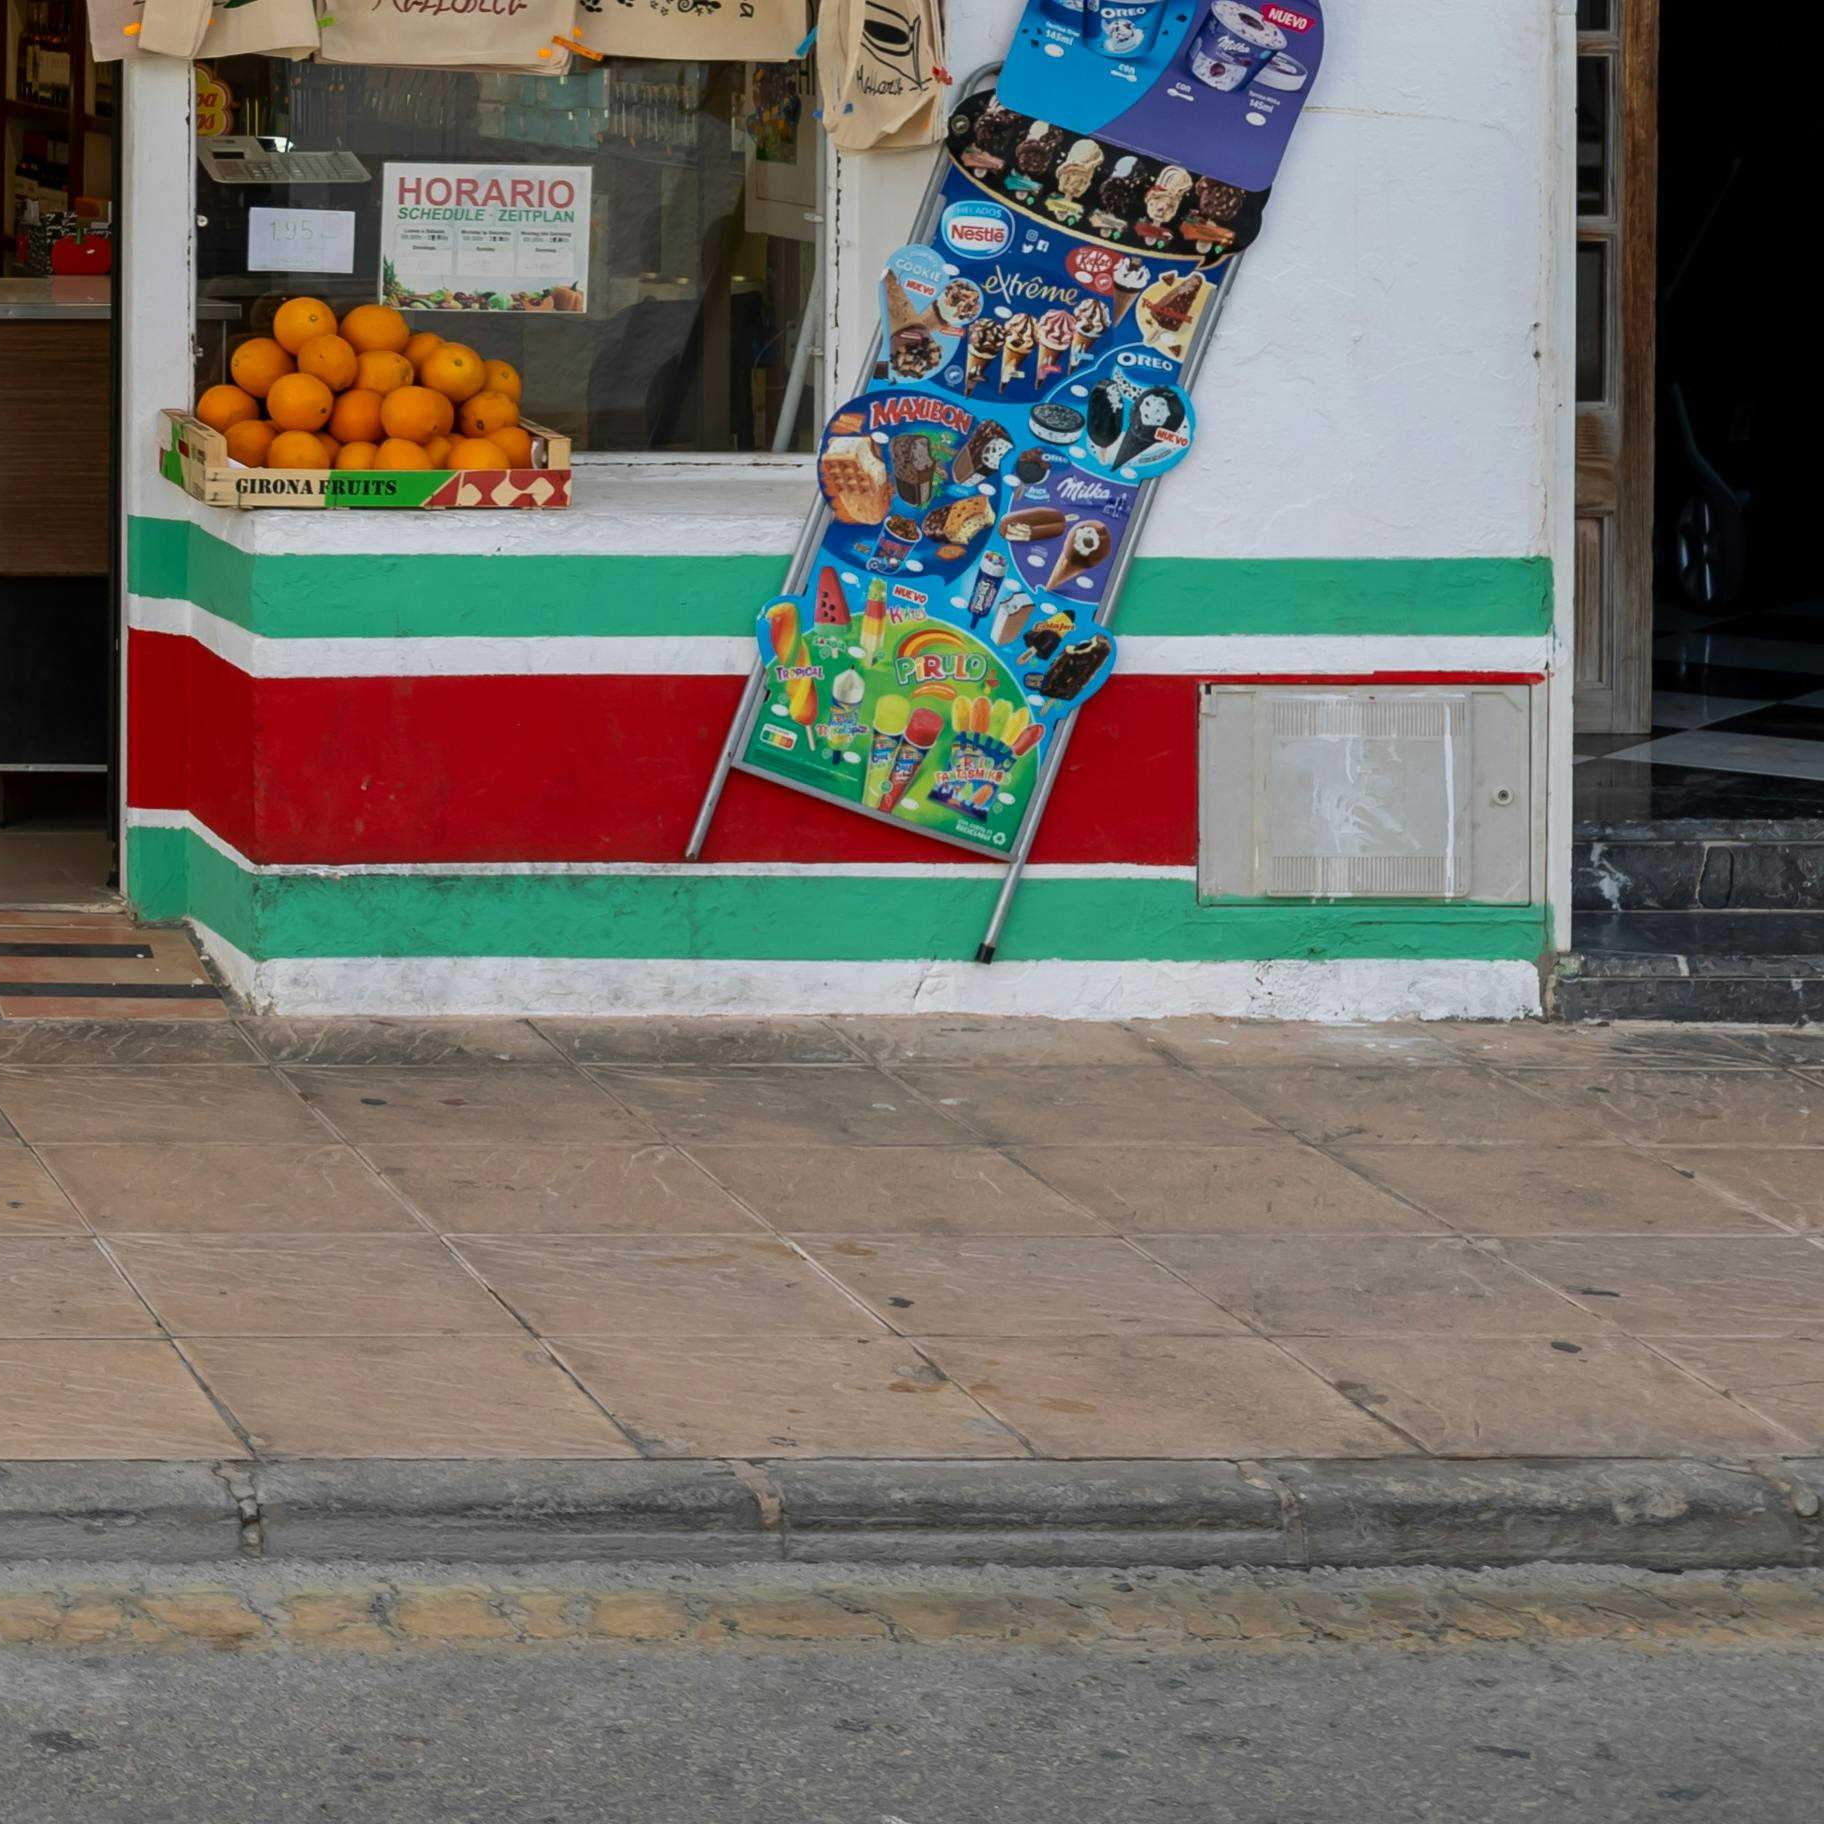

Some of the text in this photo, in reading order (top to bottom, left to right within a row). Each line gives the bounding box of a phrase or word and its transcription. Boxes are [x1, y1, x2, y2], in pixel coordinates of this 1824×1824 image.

[1100, 6, 1147, 20] OREO
[1268, 7, 1309, 30] NUEVO
[1216, 35, 1250, 54] Milka
[397, 176, 575, 210] HORARIO
[397, 207, 485, 222] SCHEDULE
[498, 208, 575, 224] ZEITPLAN
[951, 224, 1005, 243] Nestlé
[895, 258, 941, 282] COOKIE
[905, 279, 936, 296] NUEVO
[1117, 351, 1174, 371] OREO
[870, 396, 973, 435] MAXIBON
[1156, 430, 1189, 447] NUEVO
[234, 477, 398, 497] GIRONA FRUITS
[1056, 476, 1113, 500] Milka
[893, 584, 928, 604] NUEVO
[775, 665, 826, 681] TROPICAL
